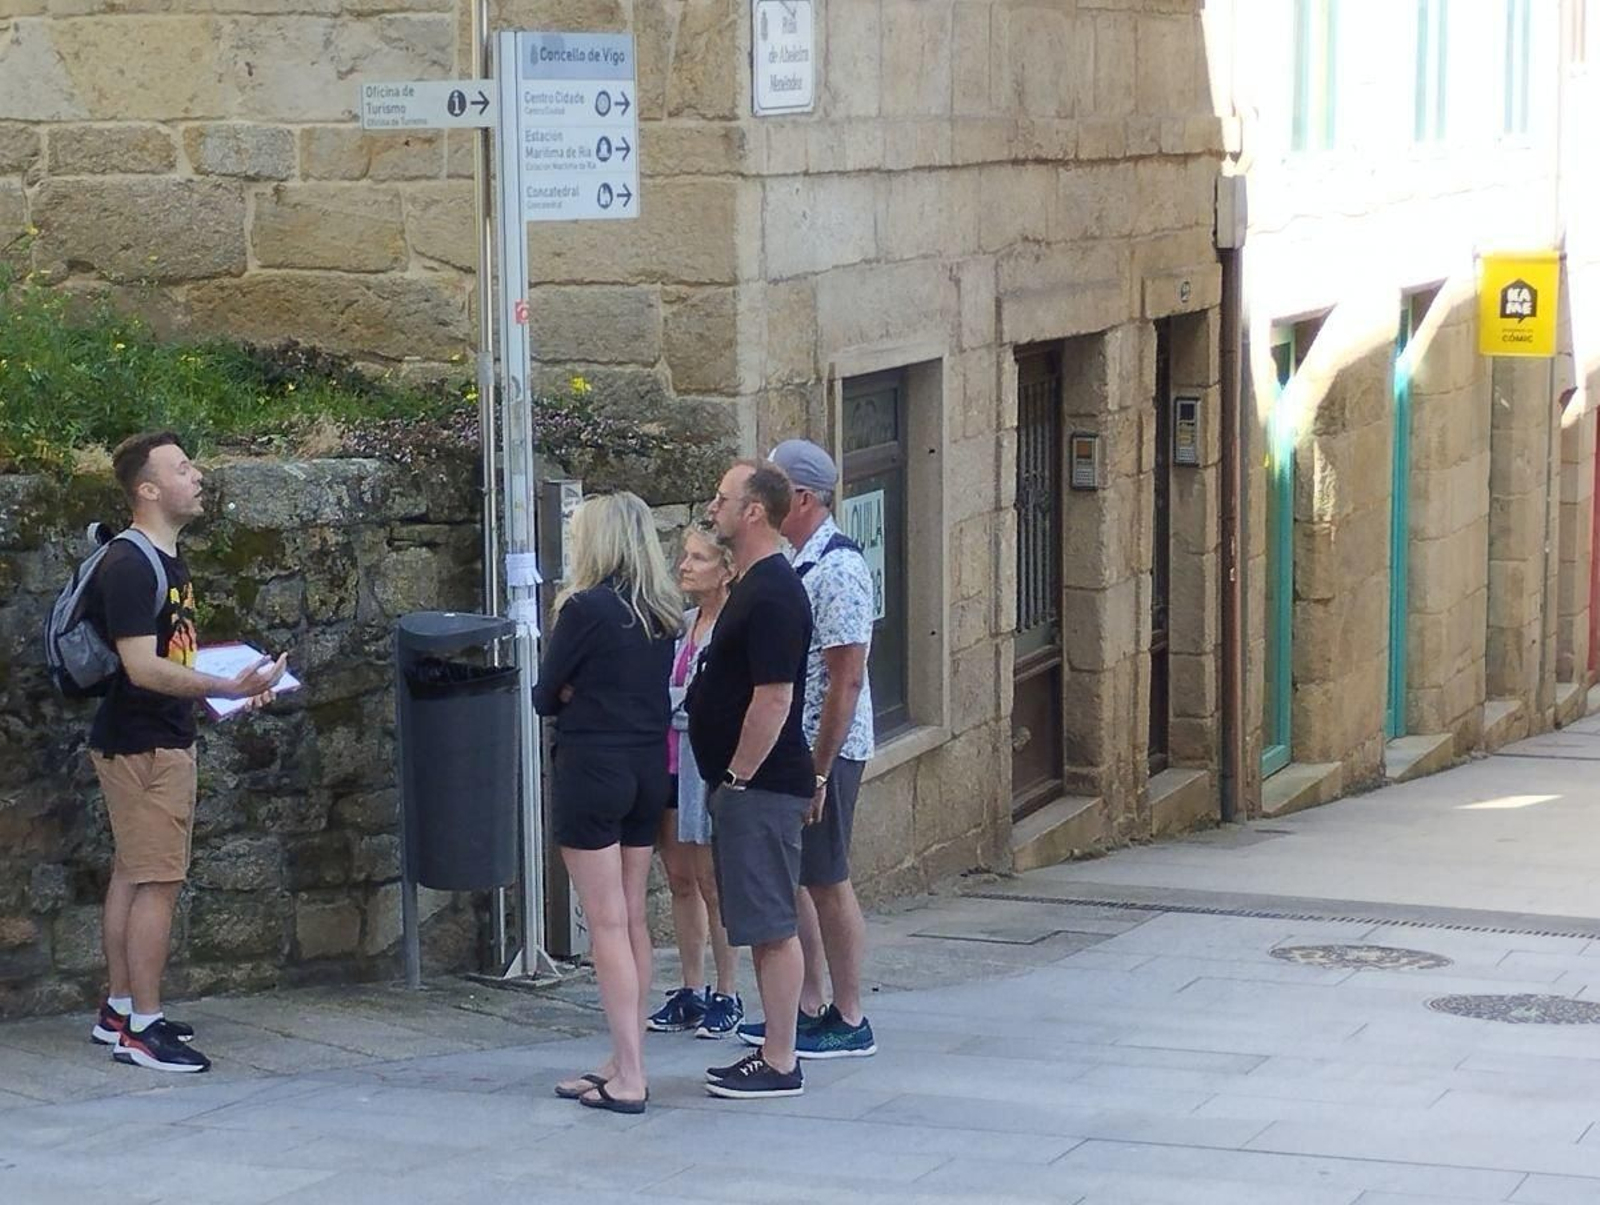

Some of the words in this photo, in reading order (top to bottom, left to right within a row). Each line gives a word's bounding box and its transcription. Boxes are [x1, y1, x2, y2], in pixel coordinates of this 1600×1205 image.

[540, 46, 586, 62] Concello
[588, 47, 601, 62] de
[602, 47, 625, 67] Vigo
[365, 85, 400, 98] Oficina
[402, 84, 415, 97] de
[524, 91, 553, 105] Centro
[555, 91, 585, 105] Cidade
[365, 102, 406, 116] Turismo
[566, 146, 577, 159] de
[526, 184, 580, 199] Concatedral
